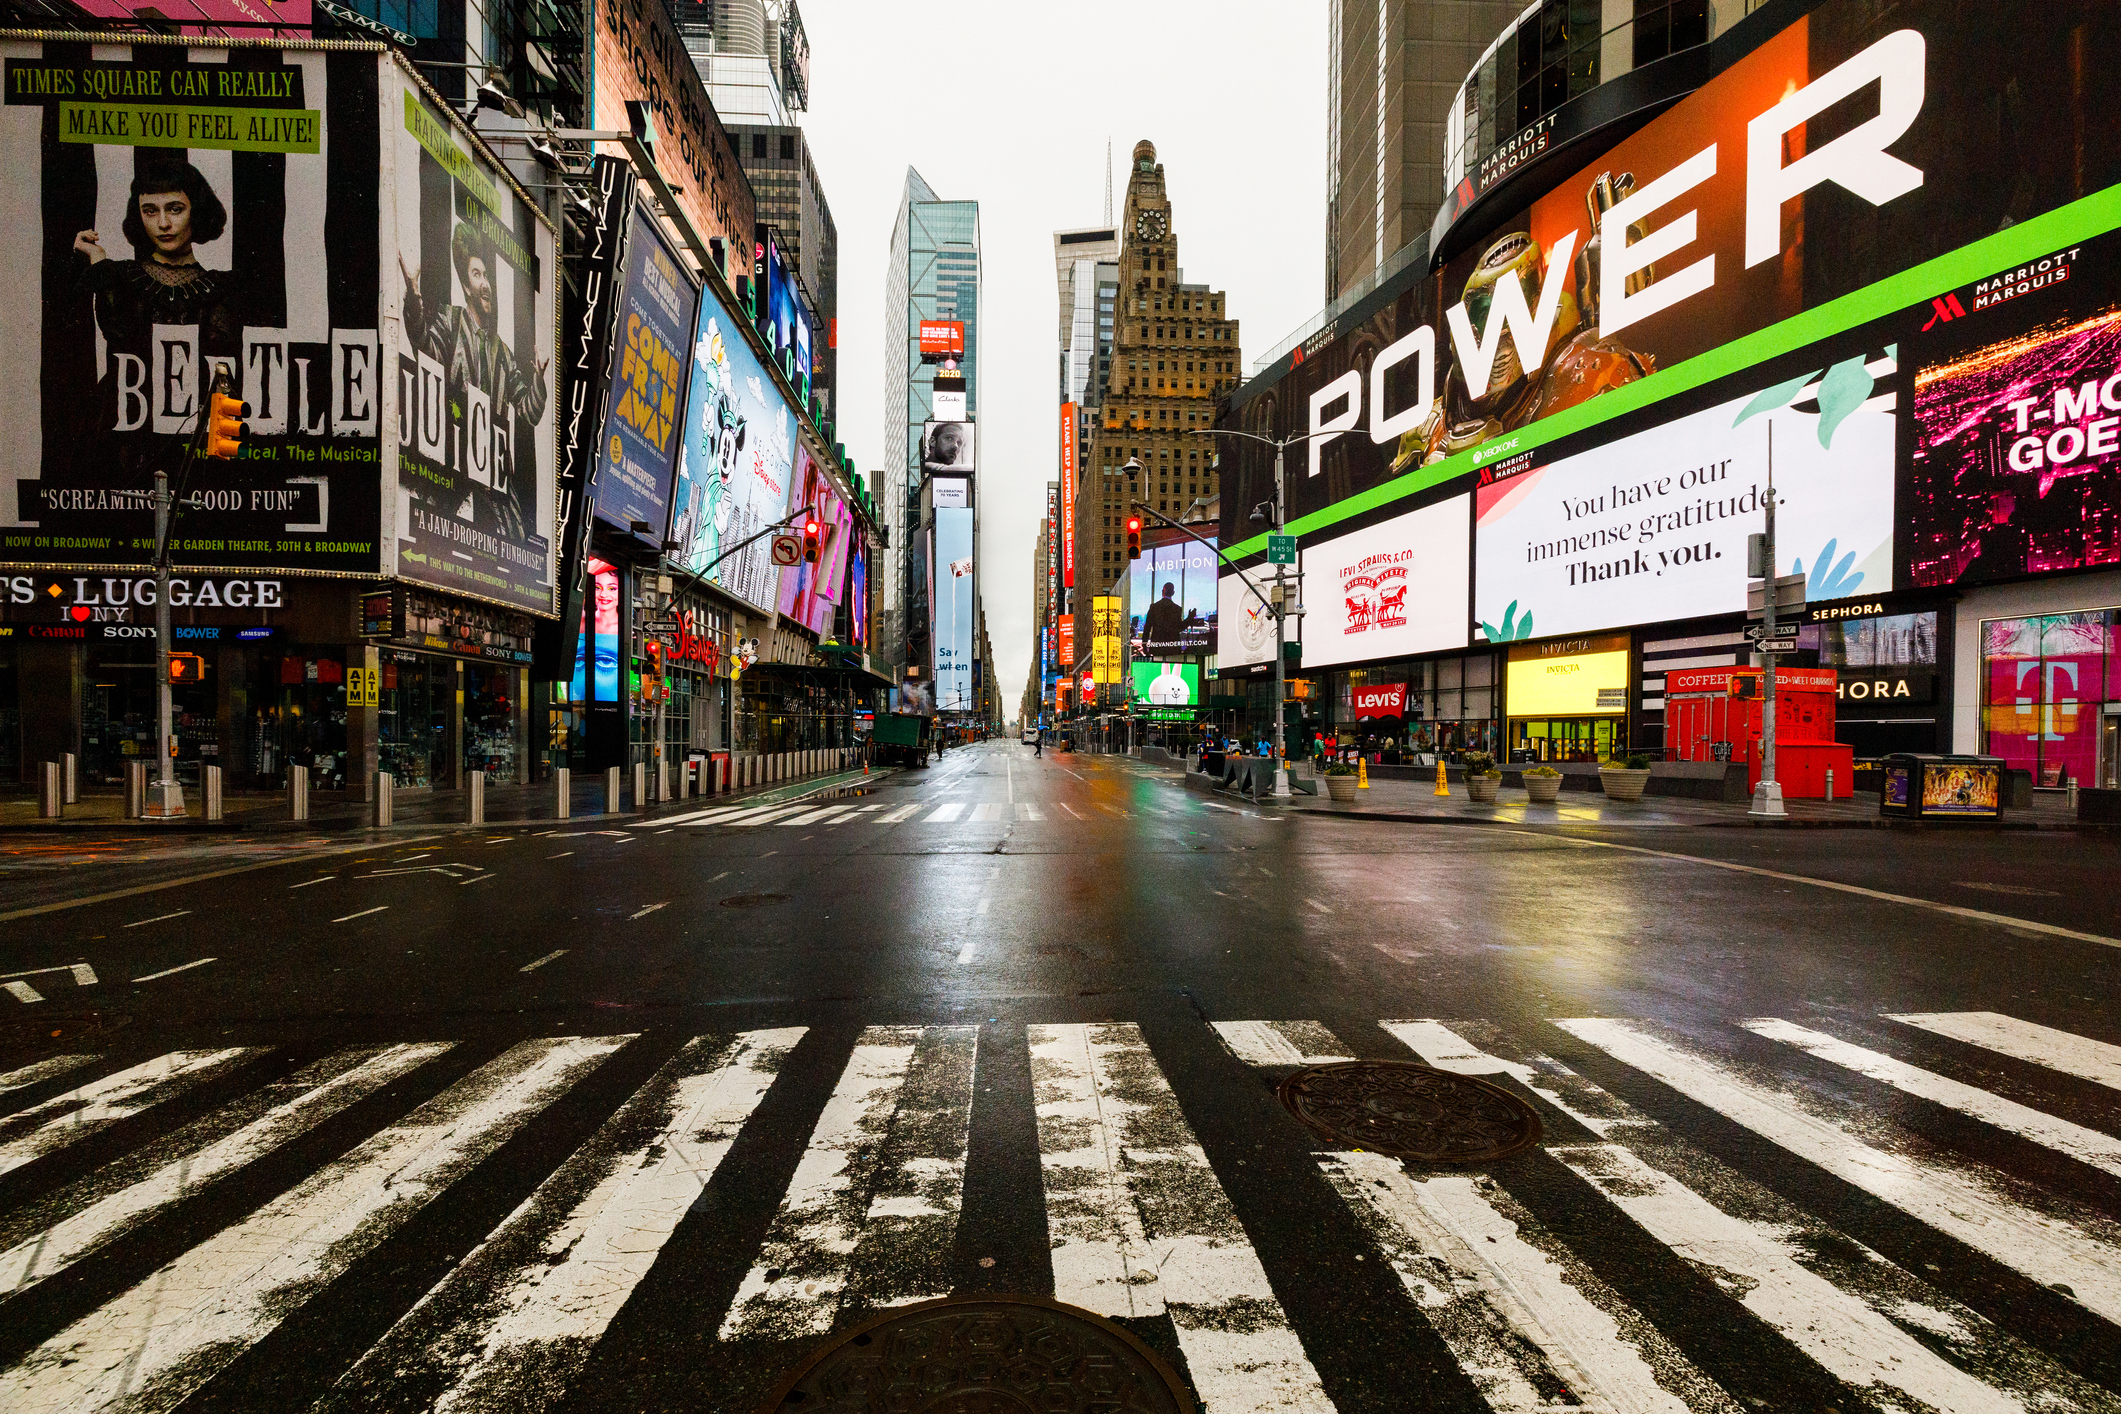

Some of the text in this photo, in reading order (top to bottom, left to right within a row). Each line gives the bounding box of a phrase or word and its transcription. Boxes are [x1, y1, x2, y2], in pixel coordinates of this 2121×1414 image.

[13, 67, 295, 100] TIMES SQUARE CAN REALLY
[68, 108, 313, 143] MAKE YOU FEEL ALIVE!
[1481, 113, 1557, 174] MARRIOTT
[414, 107, 496, 212] RAISING SPIRITS
[1480, 137, 1546, 189] MARQUIS
[466, 196, 532, 276] ON BROADWAY!
[1308, 29, 1926, 478] POWER
[1976, 248, 2080, 295] MARRIOTT
[1975, 268, 2067, 310] MARQUIS
[630, 296, 682, 362] COME TOGETHER AT
[1306, 319, 1338, 348] MARRIOTT
[627, 312, 681, 393] COME
[1306, 332, 1334, 357] MARQUIS
[620, 343, 677, 426] FROM
[939, 369, 961, 378] 2020
[399, 365, 509, 495] JUICE
[615, 386, 673, 453] AWAY
[622, 424, 648, 450] REMARKABLE
[286, 445, 315, 463] The
[320, 445, 382, 463] Musical.
[1496, 451, 1534, 471] MARRIOTT
[1495, 461, 1530, 480] MARQUIS
[40, 488, 301, 512] “SCREAMING GOOD FUN!”
[1561, 457, 1732, 522] You have our
[427, 513, 498, 555] JAW-DROPPING
[1526, 483, 1786, 564] immense gratitude.
[5, 536, 372, 554] NOW ON BROADWAY WIER GARDEN THEATRE, 50TH & BROADWAY
[429, 557, 442, 570] THIS
[443, 561, 455, 574] WAY
[455, 564, 463, 576] TO
[464, 567, 473, 579] THE
[1146, 556, 1213, 572] AMBITION
[1358, 553, 1392, 573] STRAUSS
[1564, 539, 1722, 587] Thank you.
[73, 577, 283, 608] LUGGAGE
[60, 606, 130, 623] I NY
[1812, 603, 1884, 620] SEPHORA
[28, 625, 85, 638] Canon
[103, 626, 157, 637] SONY
[176, 627, 220, 639] BOWER
[1146, 639, 1208, 648] ONEVANDERBILT.COM
[1541, 638, 1590, 655] INVICTA
[424, 635, 533, 662] Nikon Canon SONY BOWER
[1546, 664, 1580, 674] INVICTA
[1791, 676, 1809, 685] SWEET
[1809, 677, 1834, 686] CHURROS
[350, 669, 361, 701] ATM
[368, 671, 376, 701] ATM
[1835, 679, 1911, 700] HORA
